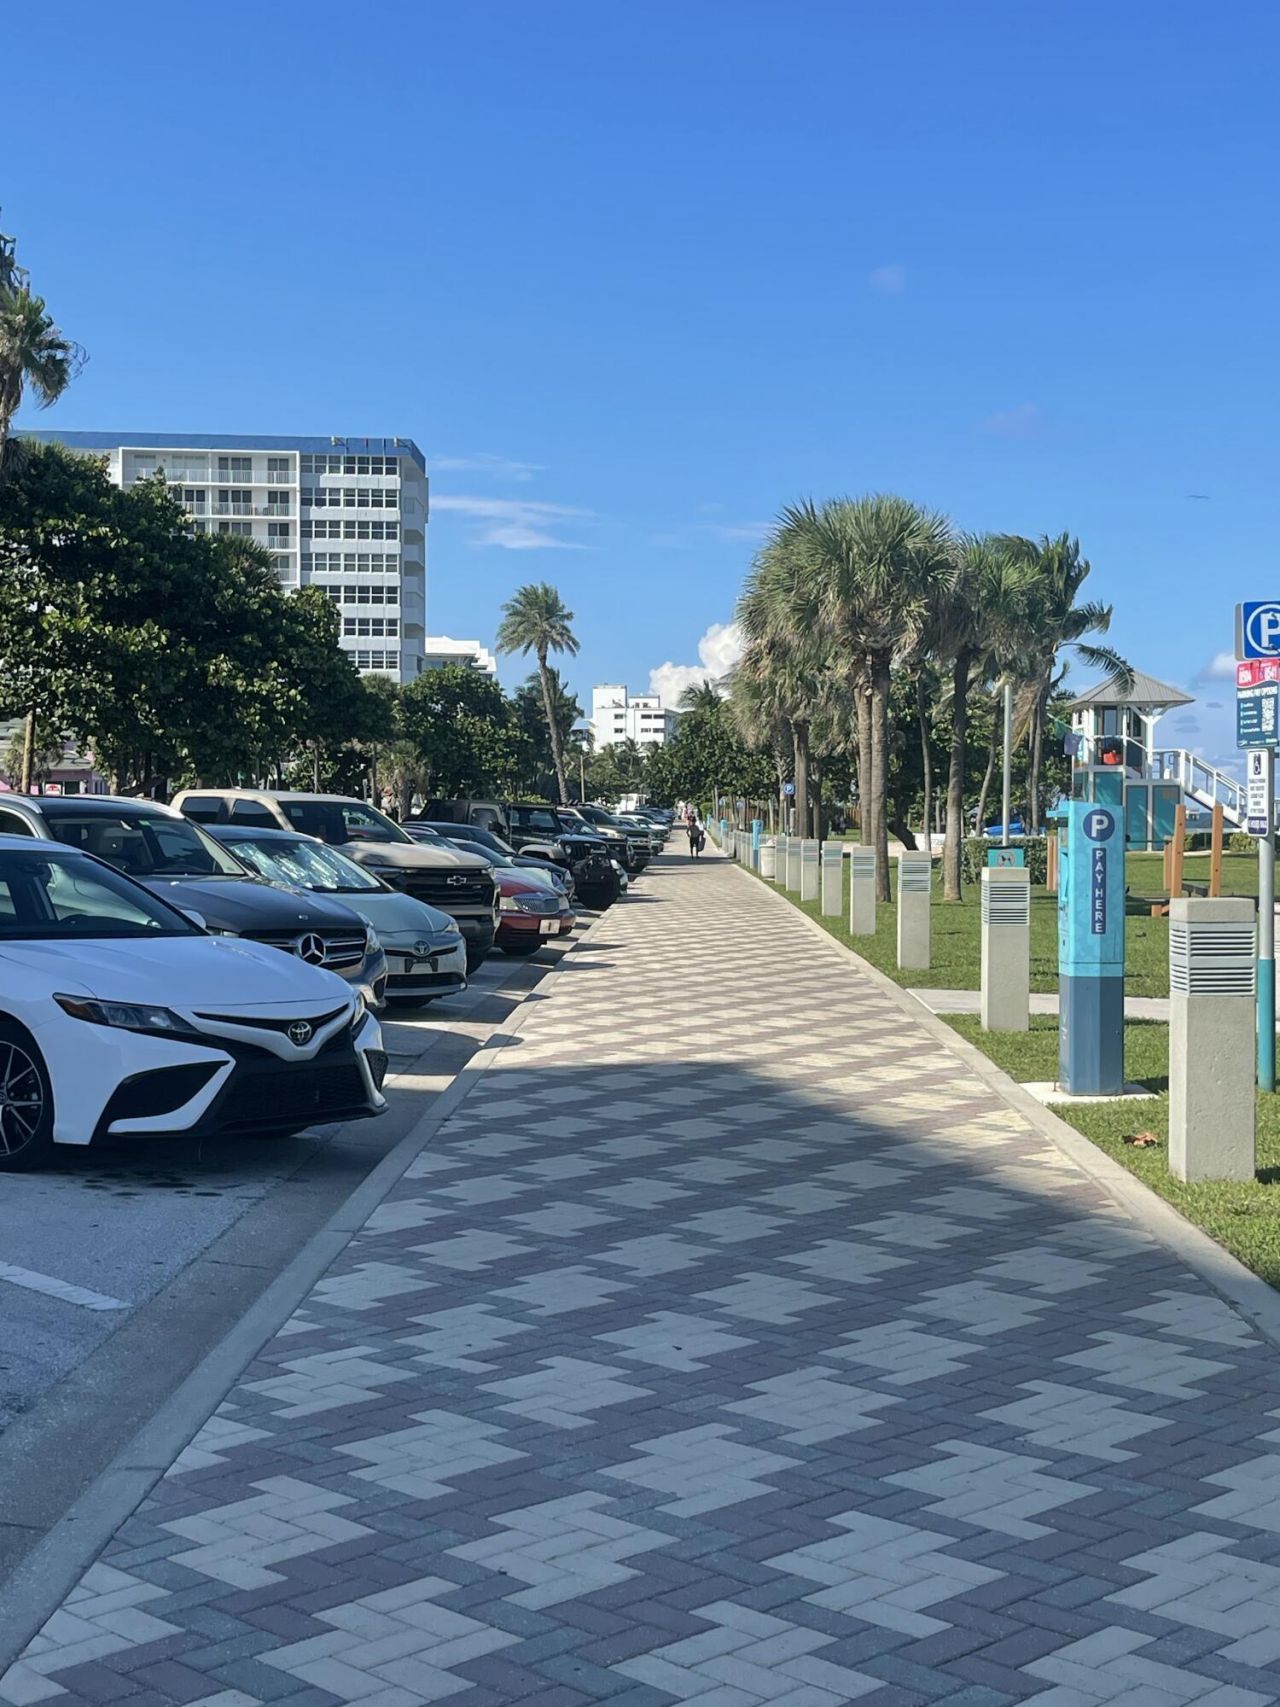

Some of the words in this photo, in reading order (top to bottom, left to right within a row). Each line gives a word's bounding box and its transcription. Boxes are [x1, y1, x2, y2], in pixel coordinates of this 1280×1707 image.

[1260, 612, 1280, 648] P
[1091, 815, 1109, 838] P
[1095, 850, 1104, 883] PAY
[1095, 888, 1104, 933] HERE
